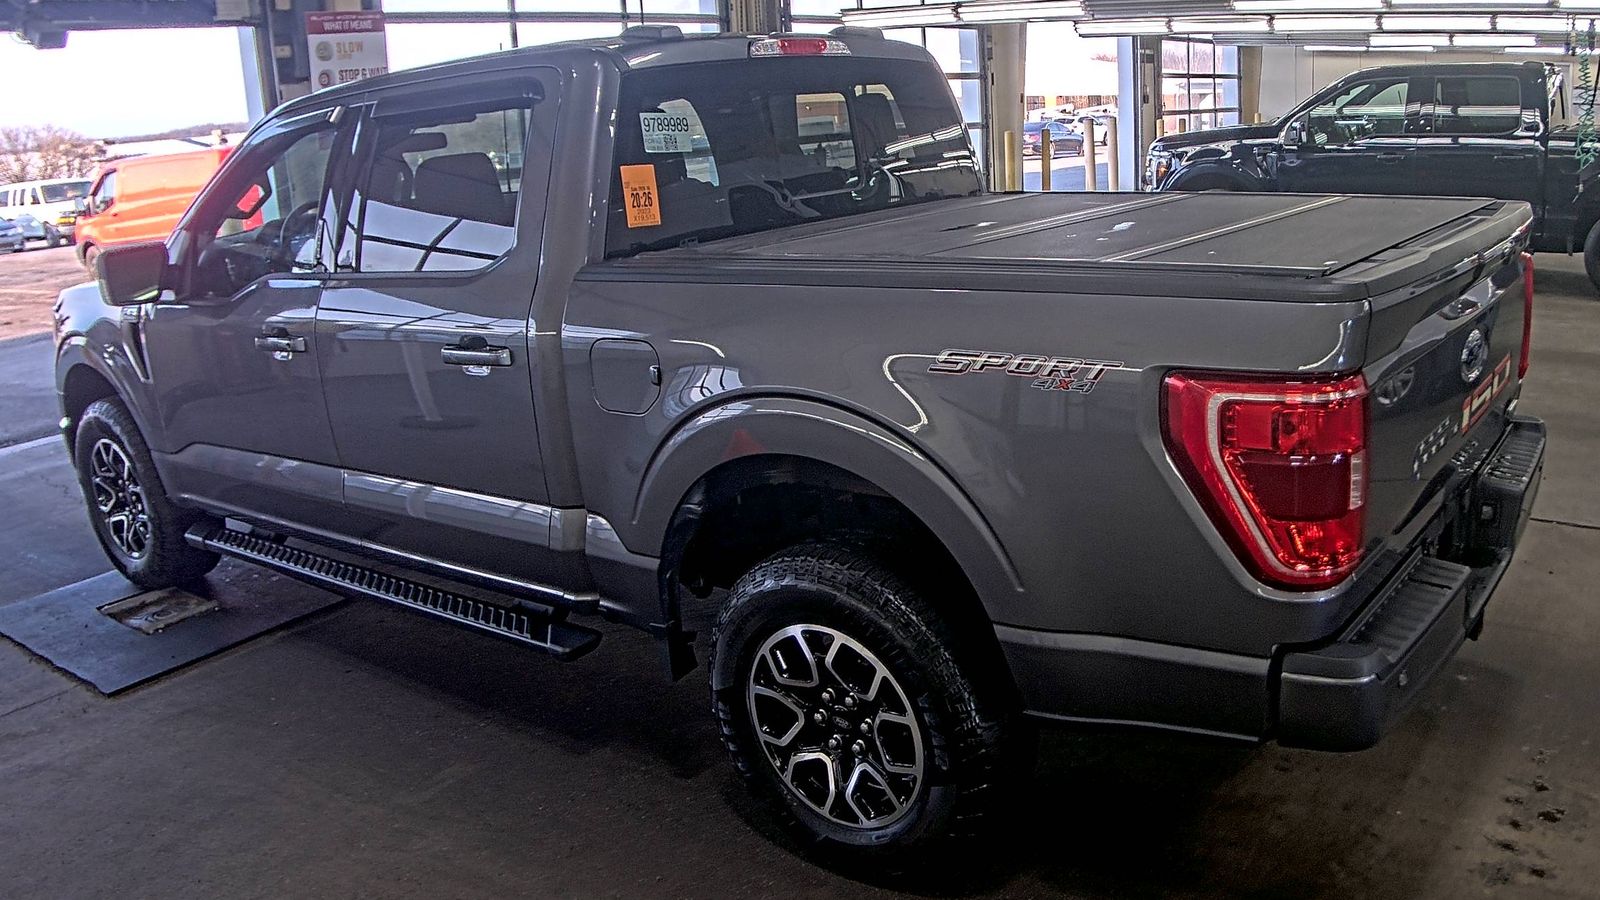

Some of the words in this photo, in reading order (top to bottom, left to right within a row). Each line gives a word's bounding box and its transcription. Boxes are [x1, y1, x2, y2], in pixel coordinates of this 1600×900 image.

[335, 41, 363, 54] SLOW
[338, 68, 360, 81] STOP
[642, 117, 689, 133] 9789989
[630, 190, 653, 209] 20:26
[927, 348, 1124, 382] SPORT
